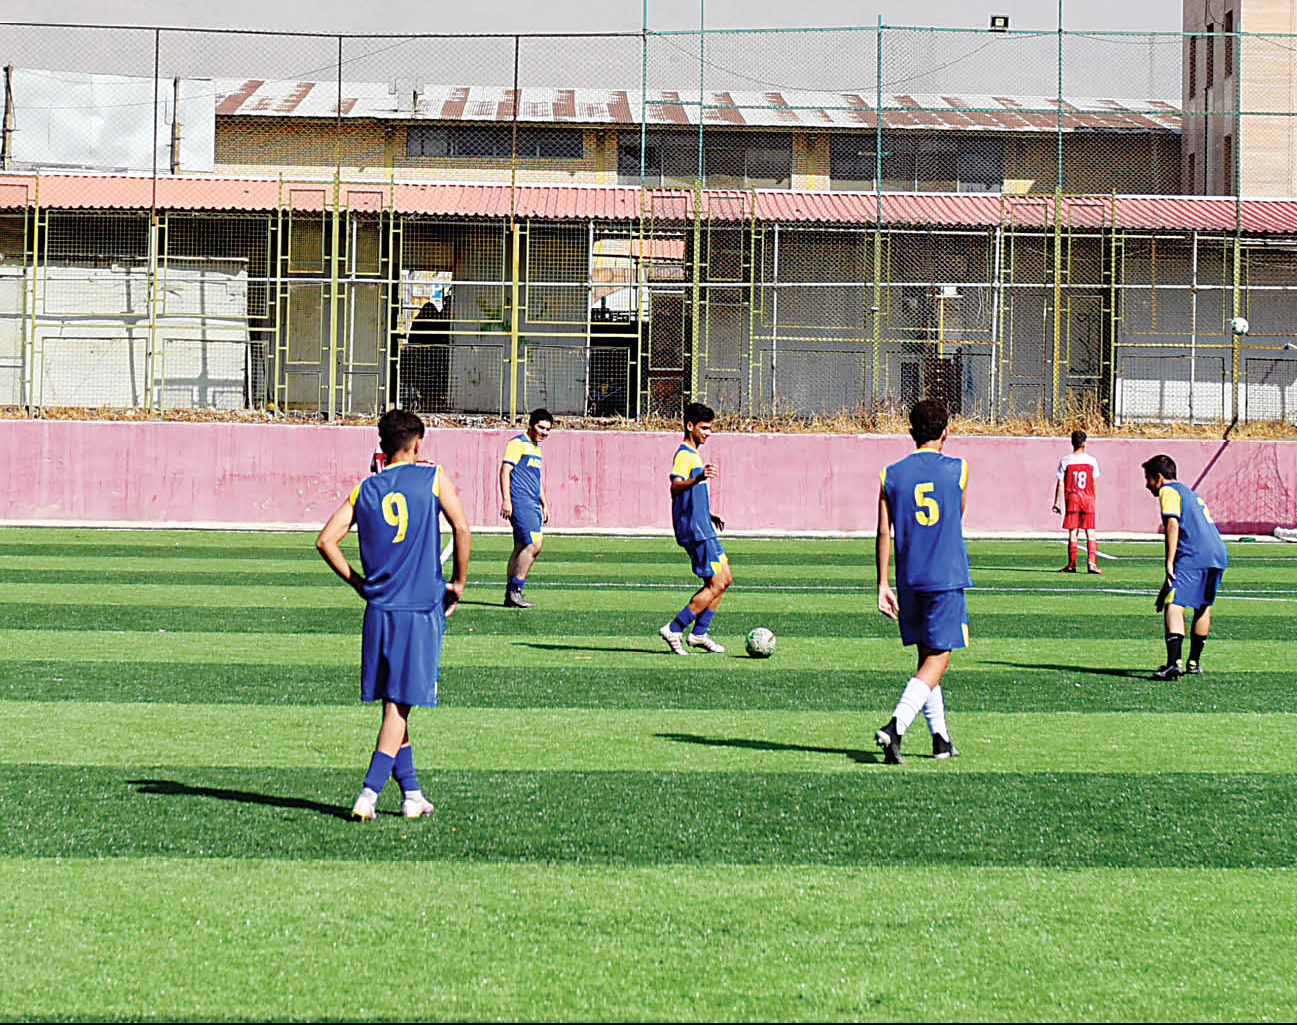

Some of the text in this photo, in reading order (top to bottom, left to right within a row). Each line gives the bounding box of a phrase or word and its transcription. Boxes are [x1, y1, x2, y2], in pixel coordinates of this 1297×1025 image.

[1072, 470, 1088, 490] 18
[381, 491, 409, 544] 9
[914, 482, 940, 526] 5
